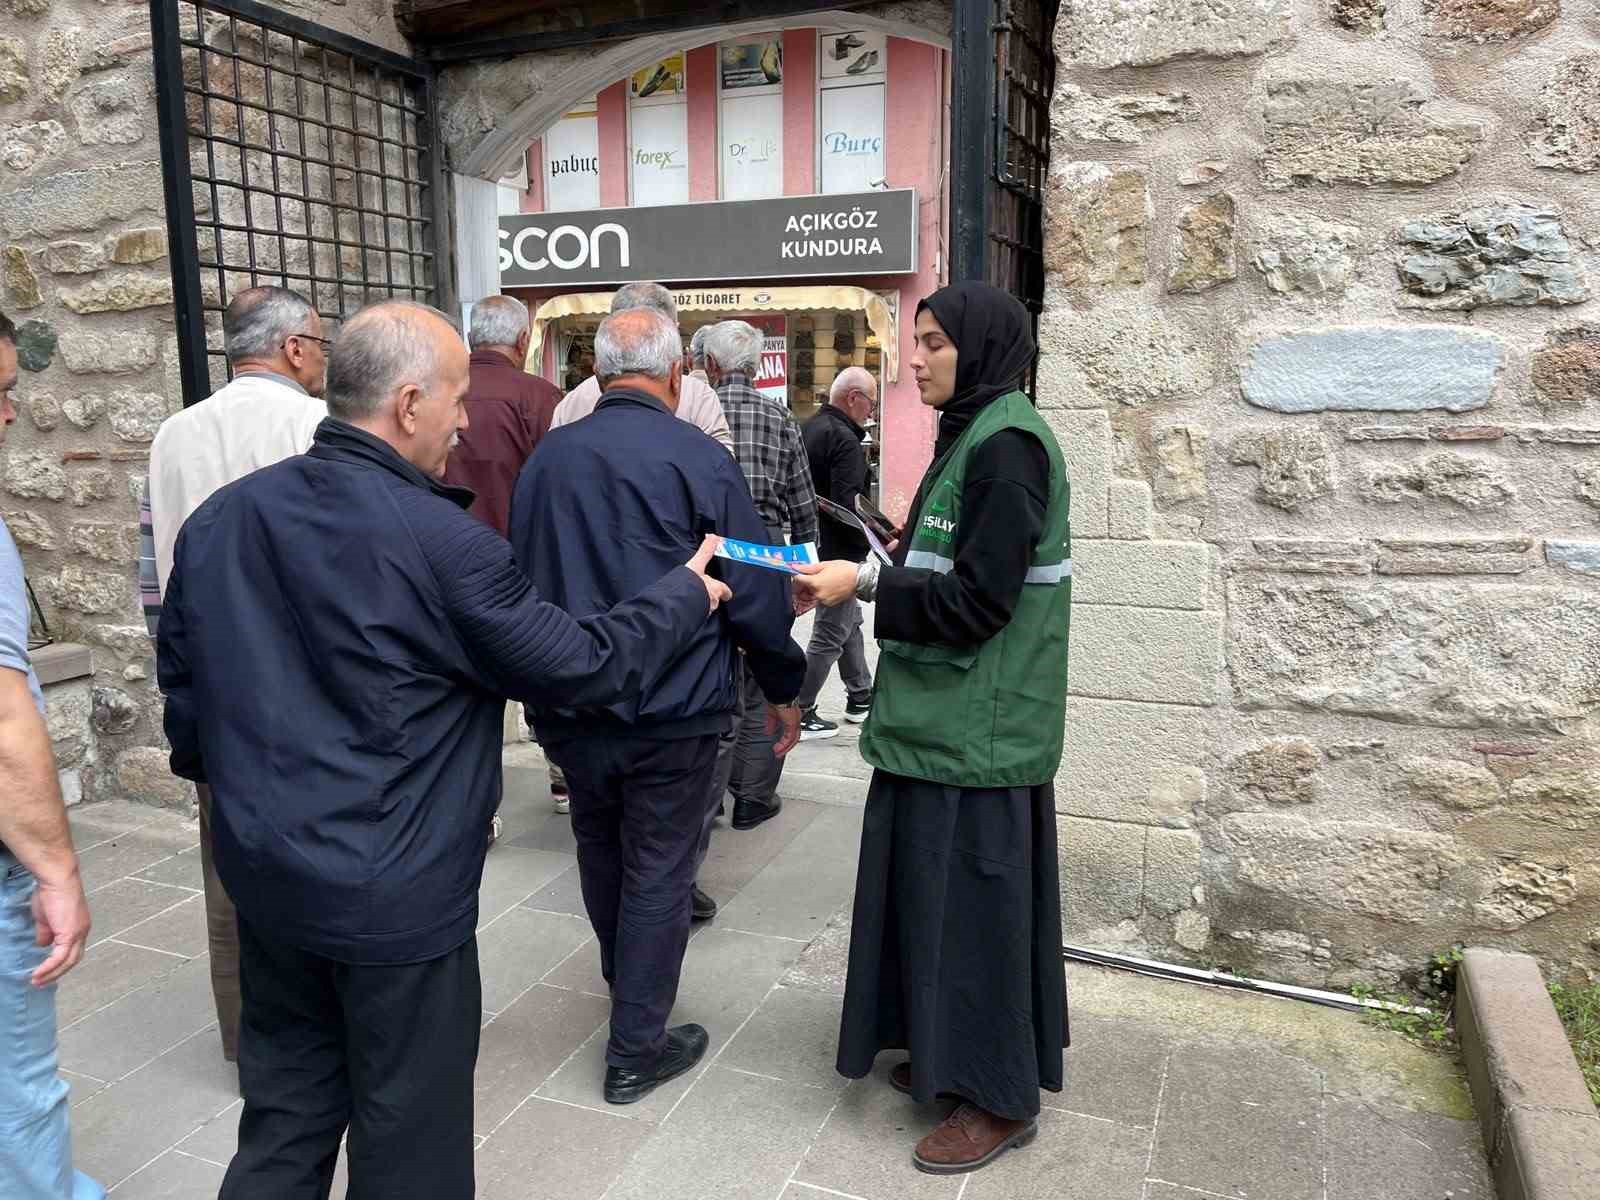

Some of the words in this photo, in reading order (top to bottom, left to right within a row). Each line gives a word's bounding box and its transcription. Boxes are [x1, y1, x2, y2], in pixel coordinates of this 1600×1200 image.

[825, 131, 881, 153] Burç
[551, 154, 599, 177] pabuç
[635, 149, 677, 170] forex
[785, 206, 878, 236] AÇIKGÖZ
[781, 238, 883, 258] KUNDURA
